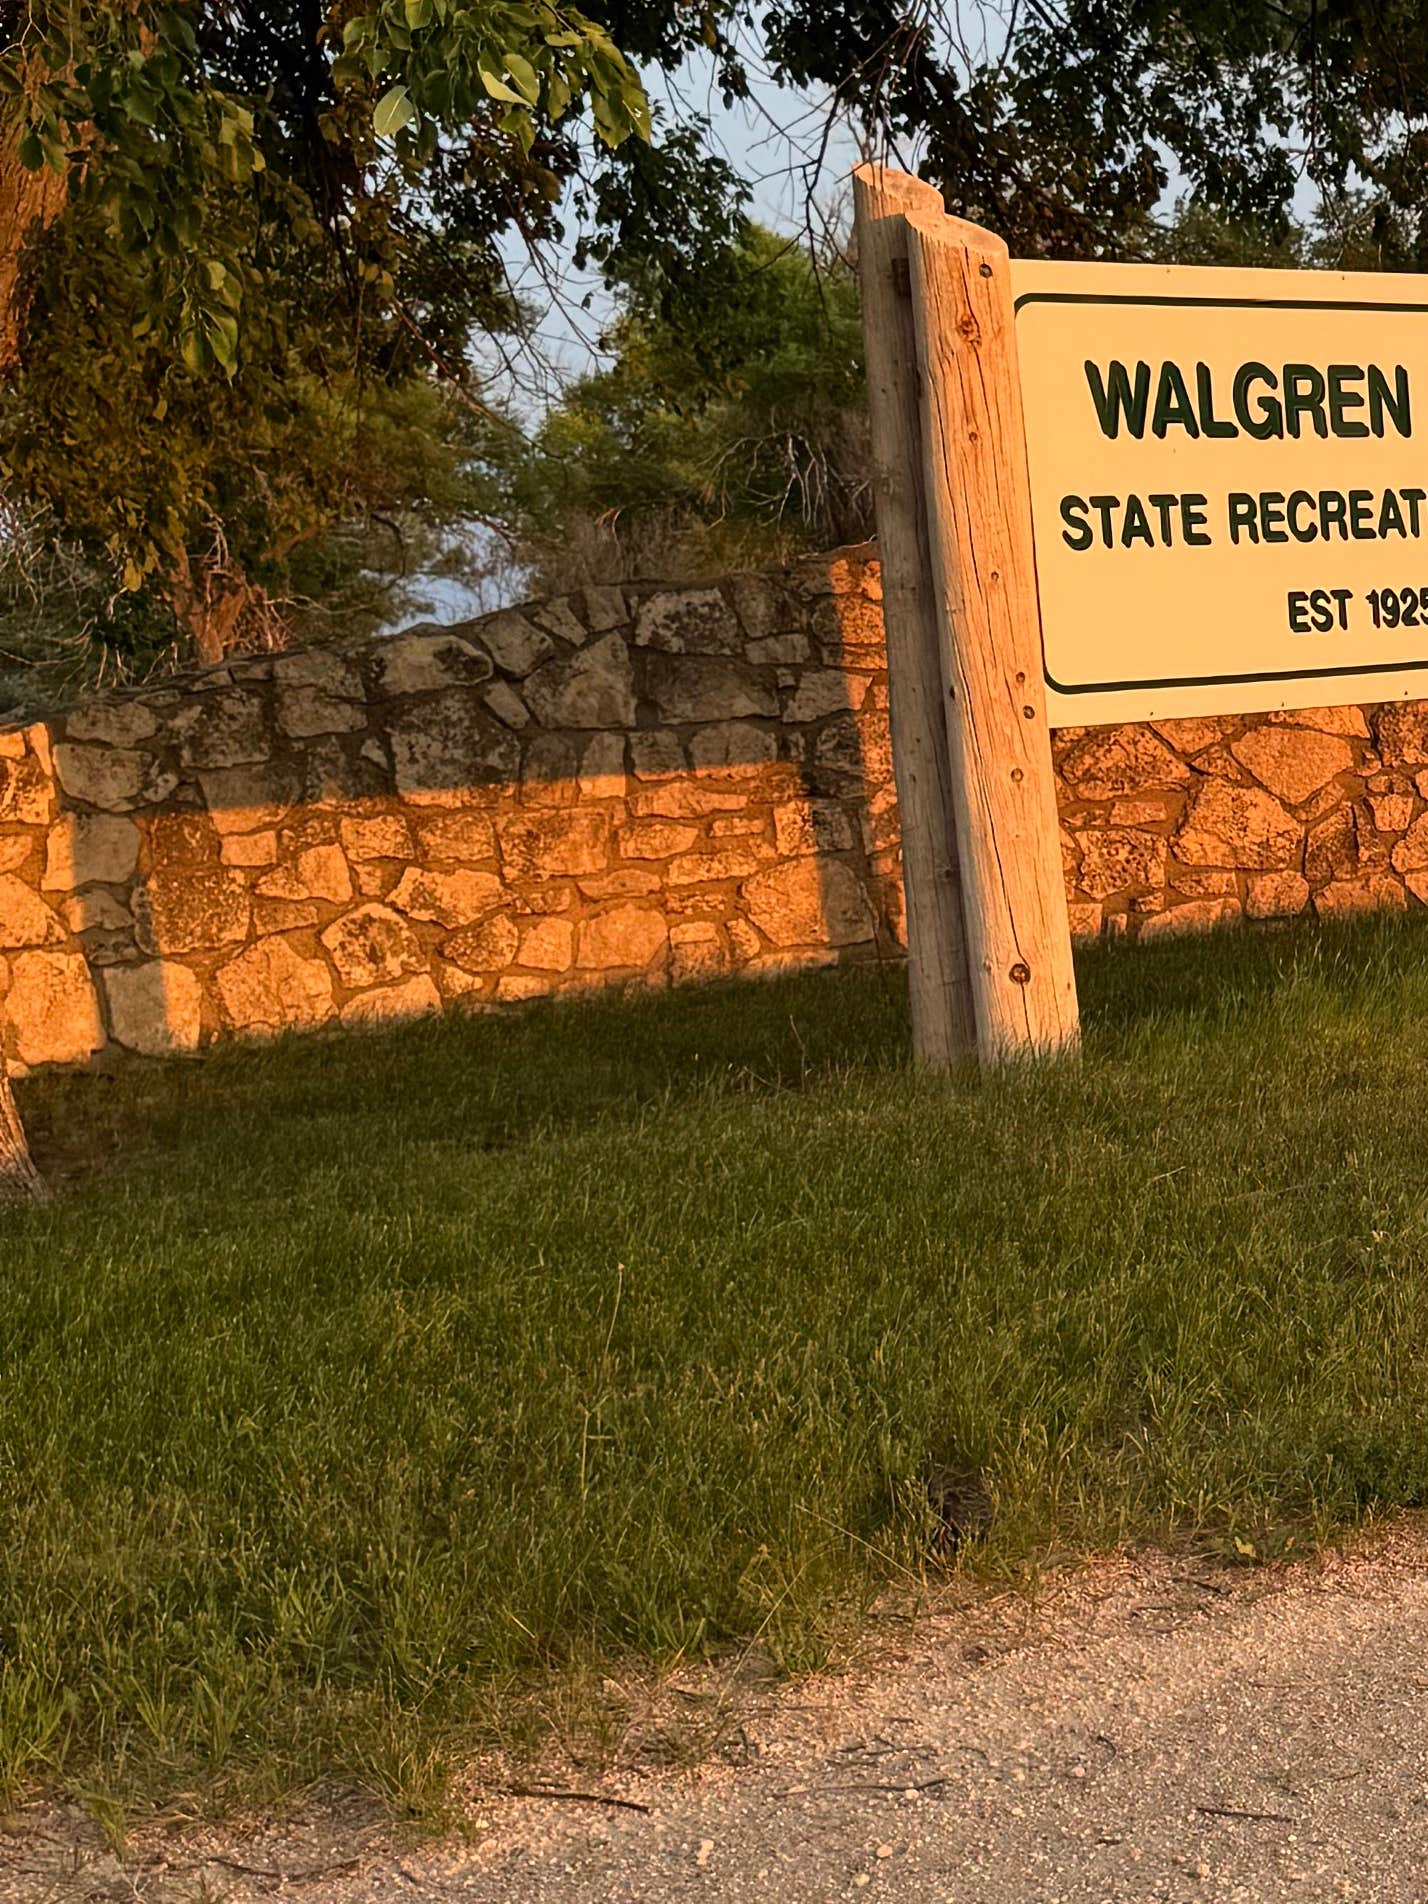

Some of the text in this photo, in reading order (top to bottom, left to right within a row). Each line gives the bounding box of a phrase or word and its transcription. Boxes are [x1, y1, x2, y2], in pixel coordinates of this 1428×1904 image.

[1084, 360, 1411, 440] WALGREN
[1060, 494, 1211, 551] STATE
[1288, 589, 1353, 633] EST
